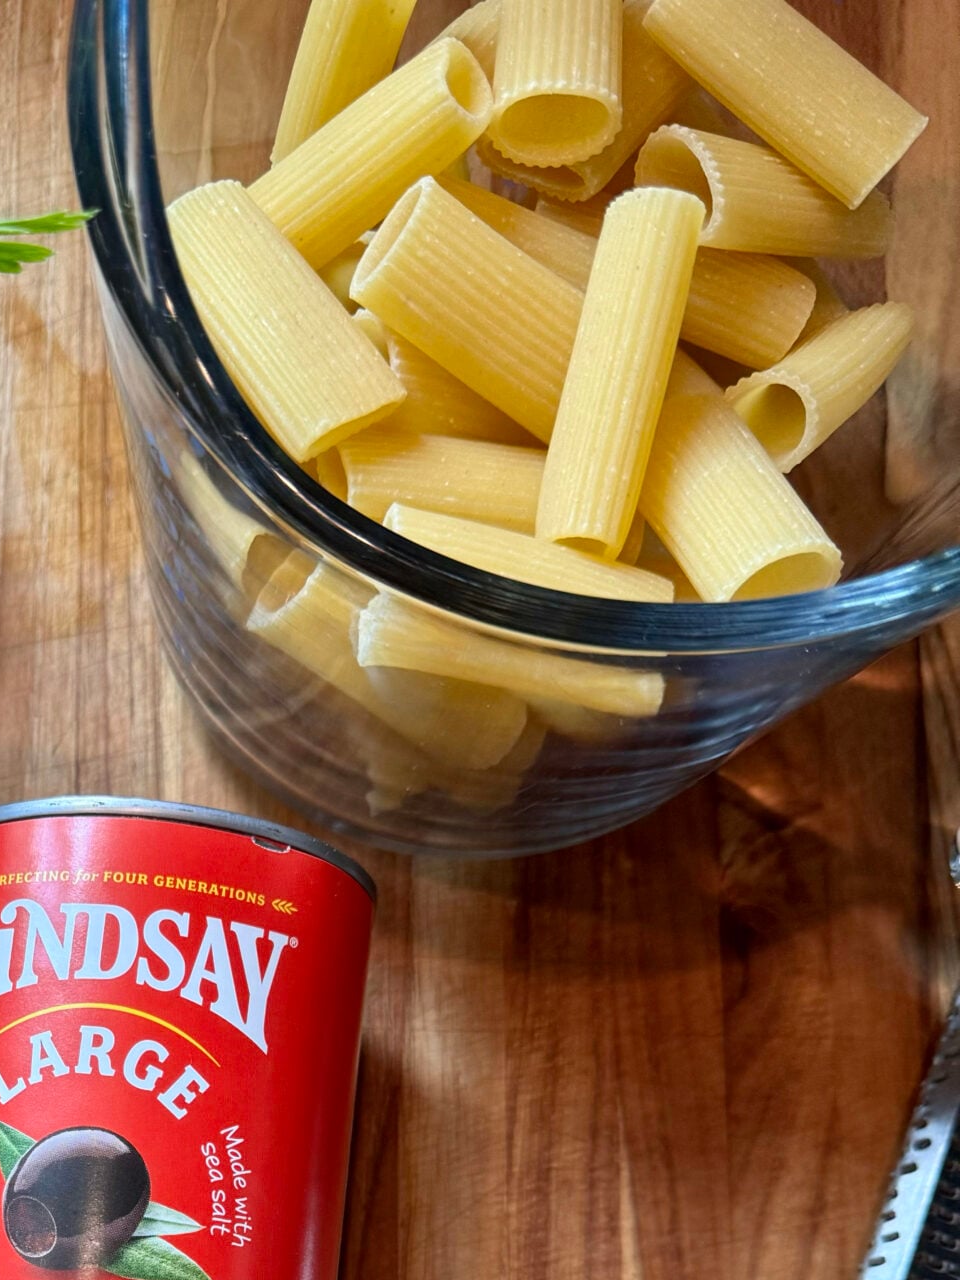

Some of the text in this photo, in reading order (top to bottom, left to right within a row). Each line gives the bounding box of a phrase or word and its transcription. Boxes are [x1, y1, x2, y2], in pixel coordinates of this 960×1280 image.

[72, 869, 99, 886] for
[103, 871, 149, 886] FOUR
[153, 875, 266, 907] GENERATIONS
[200, 1142, 232, 1236] sea salt
[220, 1124, 253, 1248] Made with
